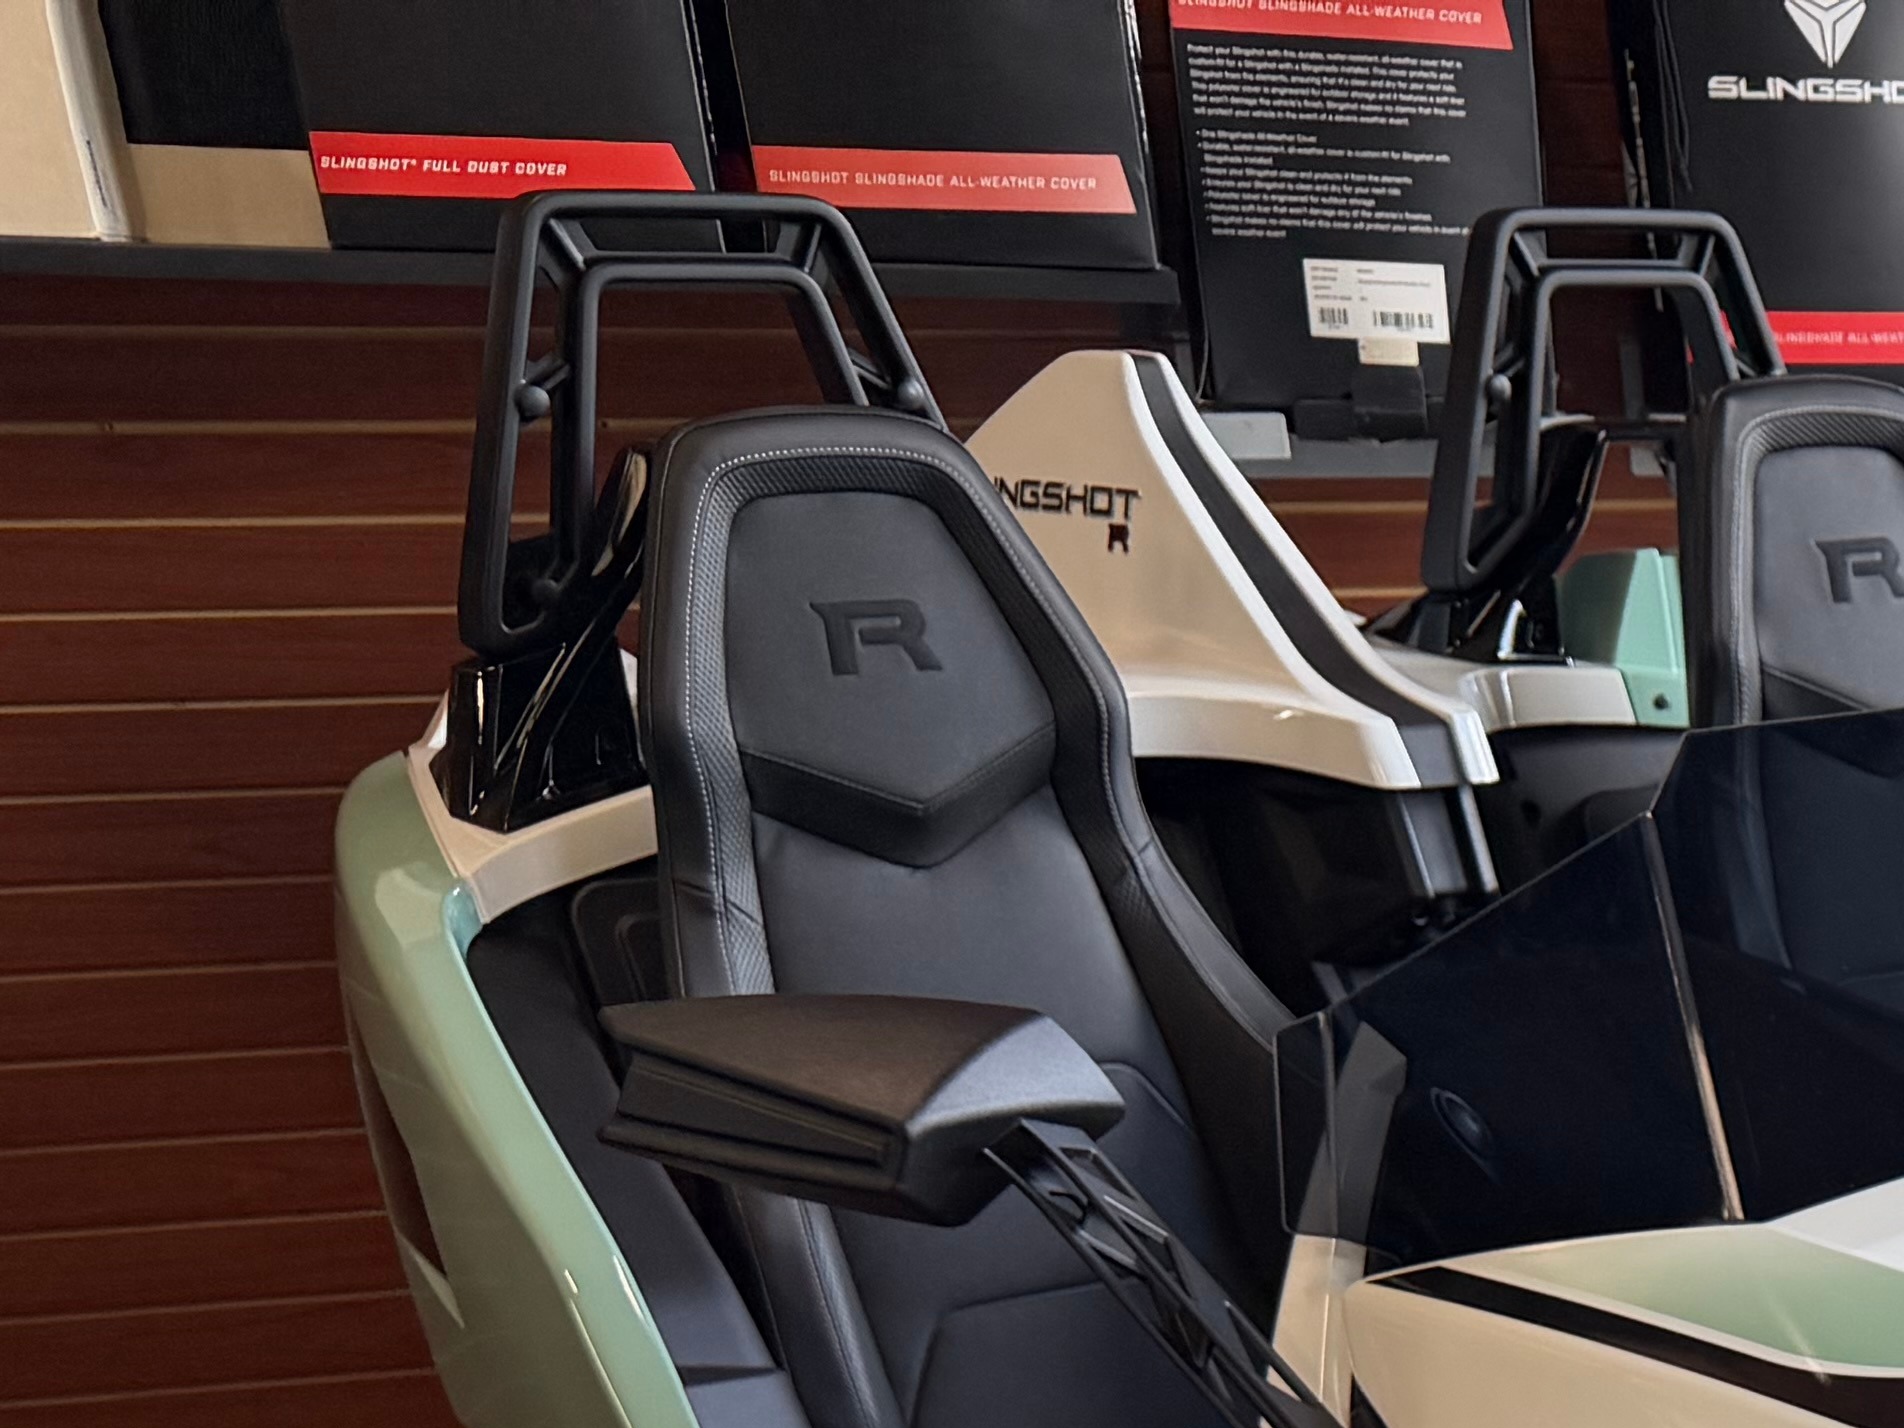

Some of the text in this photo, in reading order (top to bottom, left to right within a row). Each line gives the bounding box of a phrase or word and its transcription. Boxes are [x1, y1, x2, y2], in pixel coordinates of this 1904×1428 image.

[1347, 3, 1435, 20] ALL-WEATHER
[1439, 9, 1482, 24] COVER
[423, 159, 461, 173] FULL
[467, 160, 509, 174] DUST
[515, 162, 567, 176] COVER
[769, 169, 1097, 190] SLINGSHOT SLINGSHADE ALL-WEATHER COVER
[1775, 331, 1844, 346] LINGSHADE
[994, 476, 1141, 521] NGSHOT
[808, 598, 944, 676] R
